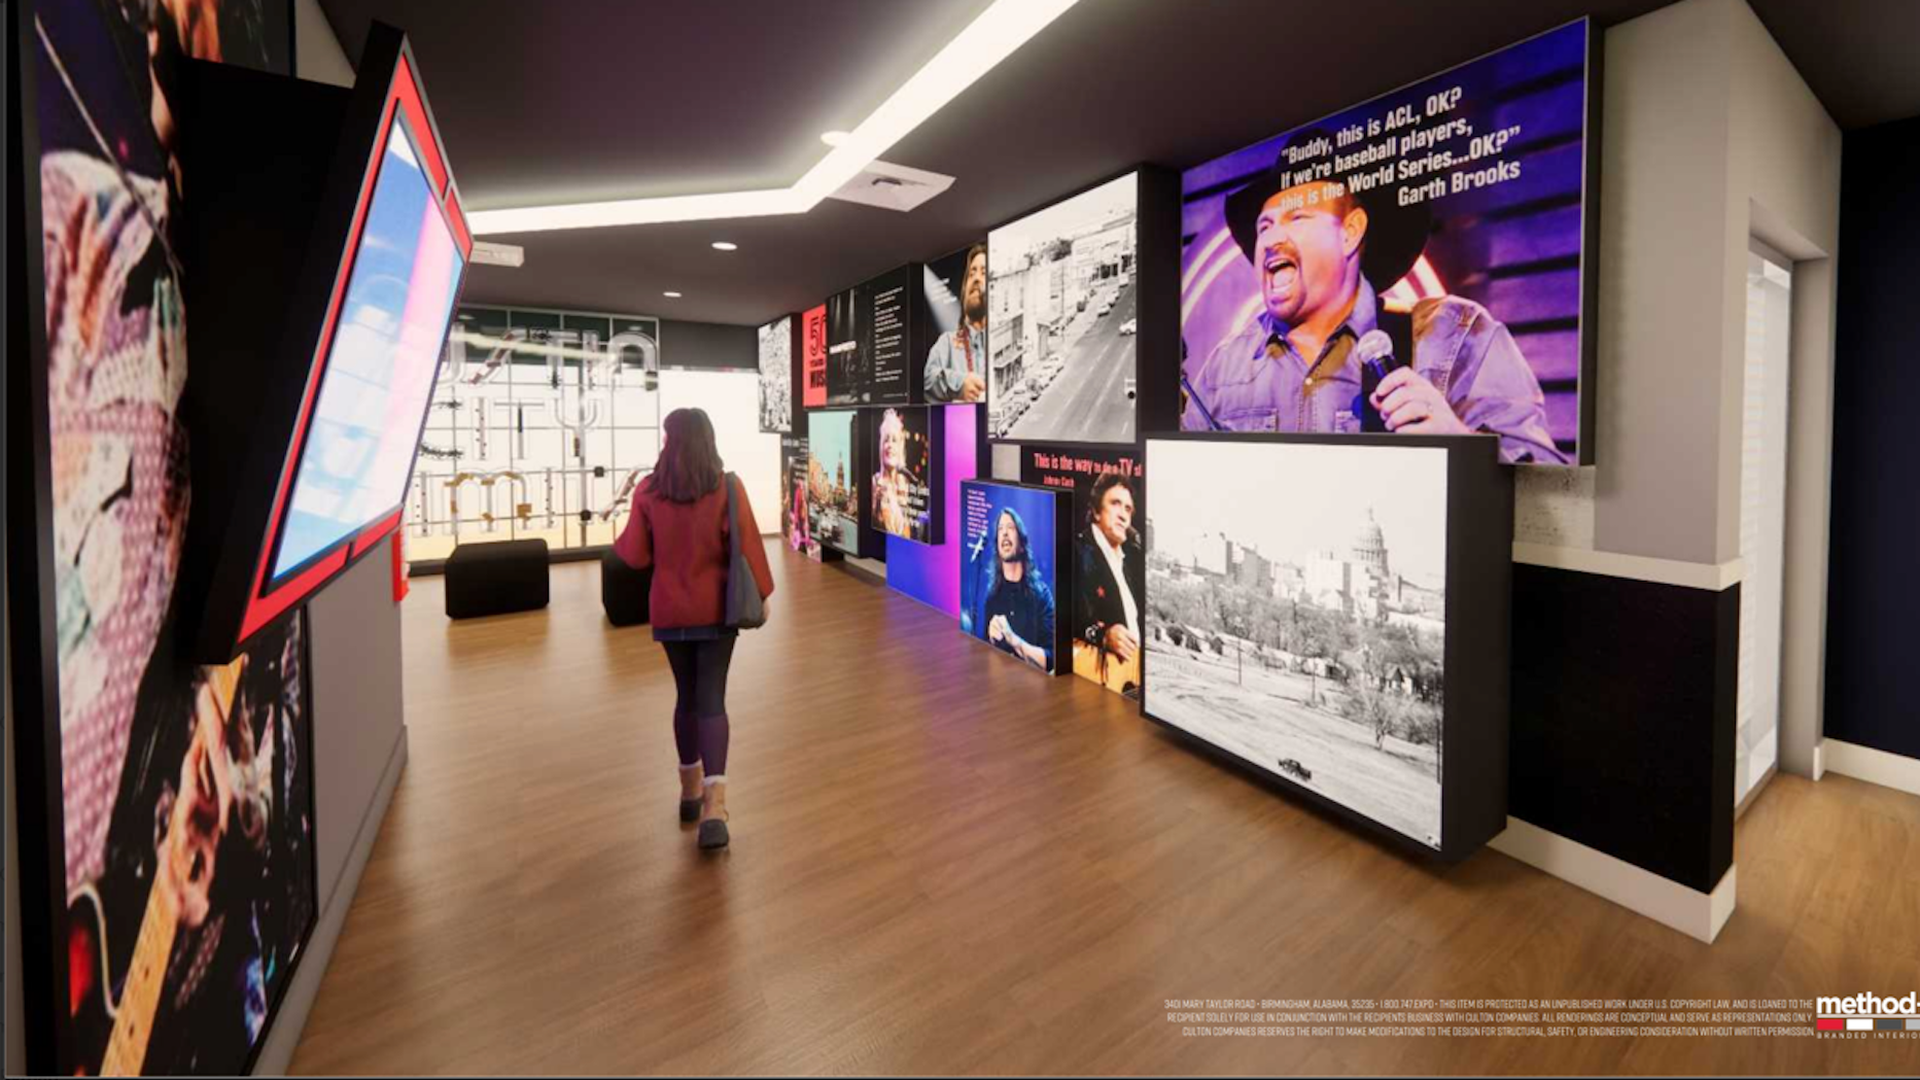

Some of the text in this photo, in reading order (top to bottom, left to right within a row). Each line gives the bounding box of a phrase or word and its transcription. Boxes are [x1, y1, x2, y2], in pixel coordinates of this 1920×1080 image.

[1336, 125, 1364, 148] this
[1367, 118, 1382, 138] is
[1384, 104, 1421, 132] ACL,
[1425, 86, 1462, 117] OK?
[1280, 171, 1292, 190] If
[1335, 136, 1397, 174] baseball
[1400, 118, 1473, 156] players,
[1307, 188, 1320, 205] is
[1322, 182, 1345, 201] the
[1347, 163, 1395, 194] World
[1398, 160, 1521, 207] Garth Brooks
[1034, 452, 1050, 469] This
[1051, 453, 1059, 470] is
[1060, 454, 1073, 471] the
[1074, 458, 1093, 475] way
[1119, 457, 1134, 477] TV
